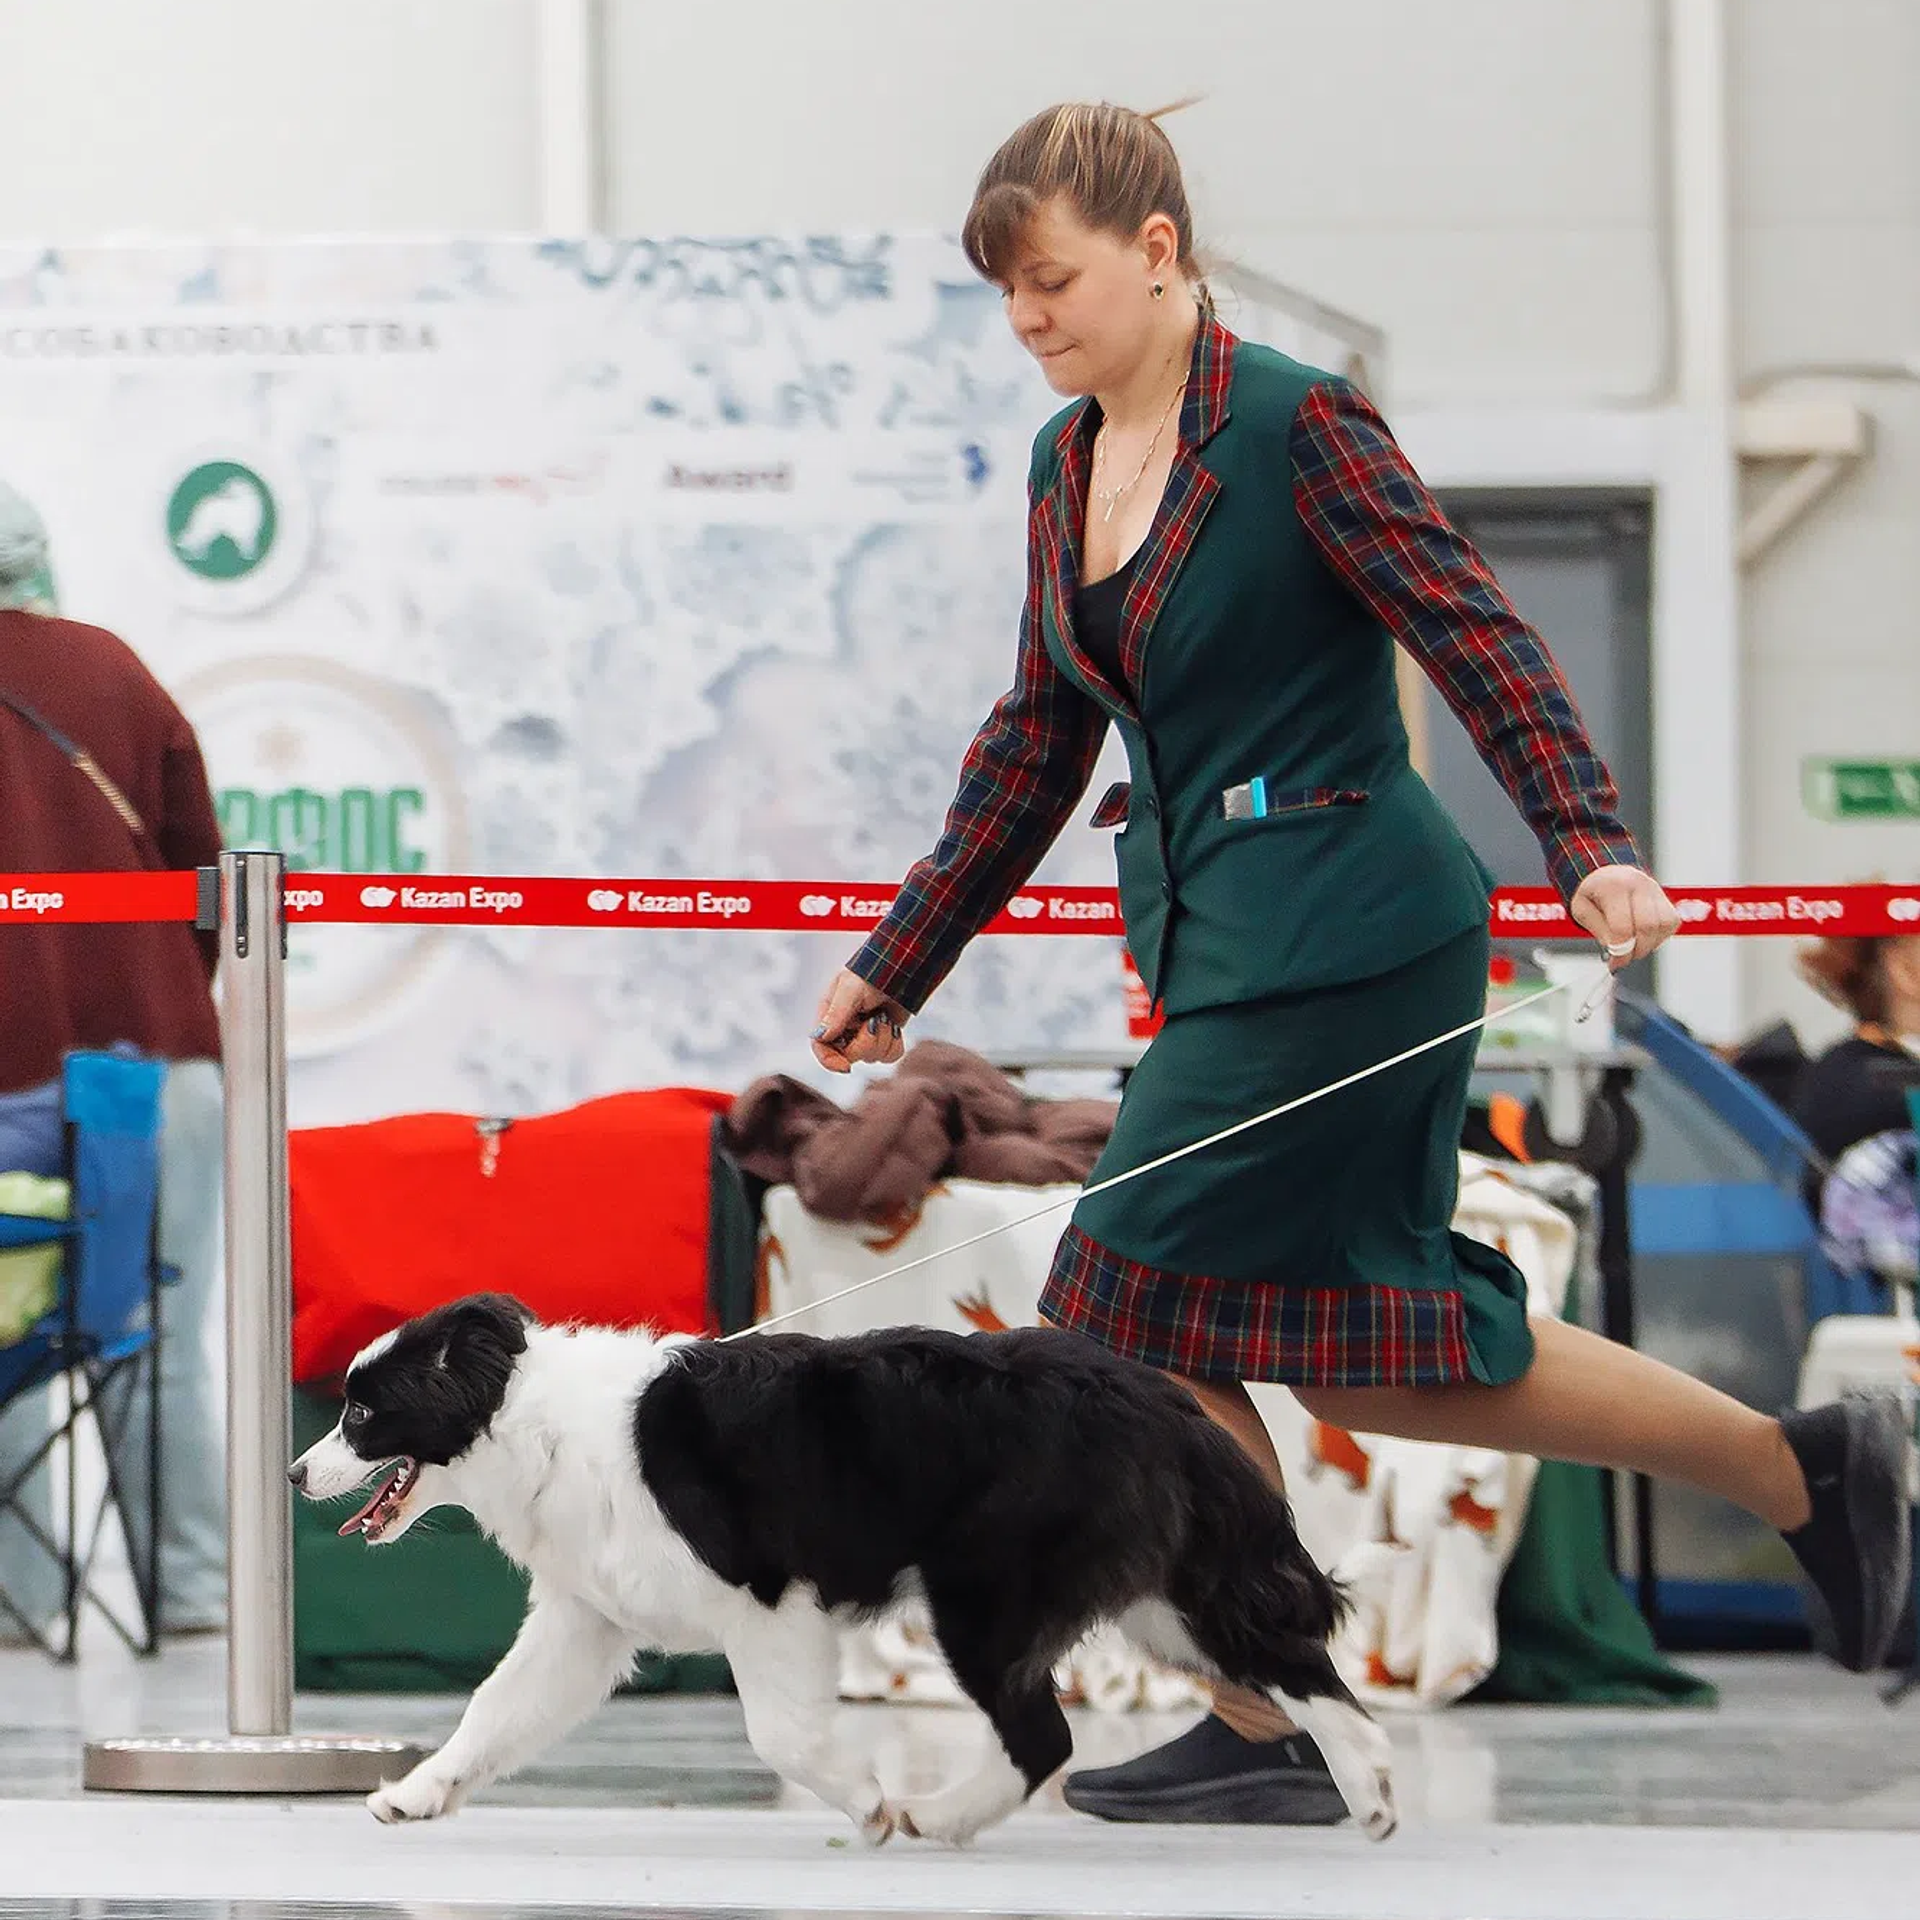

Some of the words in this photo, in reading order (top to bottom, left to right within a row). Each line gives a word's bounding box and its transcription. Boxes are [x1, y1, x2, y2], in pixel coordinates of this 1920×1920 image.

[12, 888, 64, 914] Expo
[284, 890, 324, 912] xpo
[400, 887, 466, 909] Kazan
[469, 887, 523, 913] Expo
[627, 890, 693, 913] Kazan
[696, 891, 751, 919] Expo
[840, 894, 893, 918] Kaza
[1048, 897, 1115, 920] Kazan
[1498, 899, 1566, 922] Kazan
[1715, 898, 1785, 921] Kazan
[1787, 896, 1844, 923] Expo
